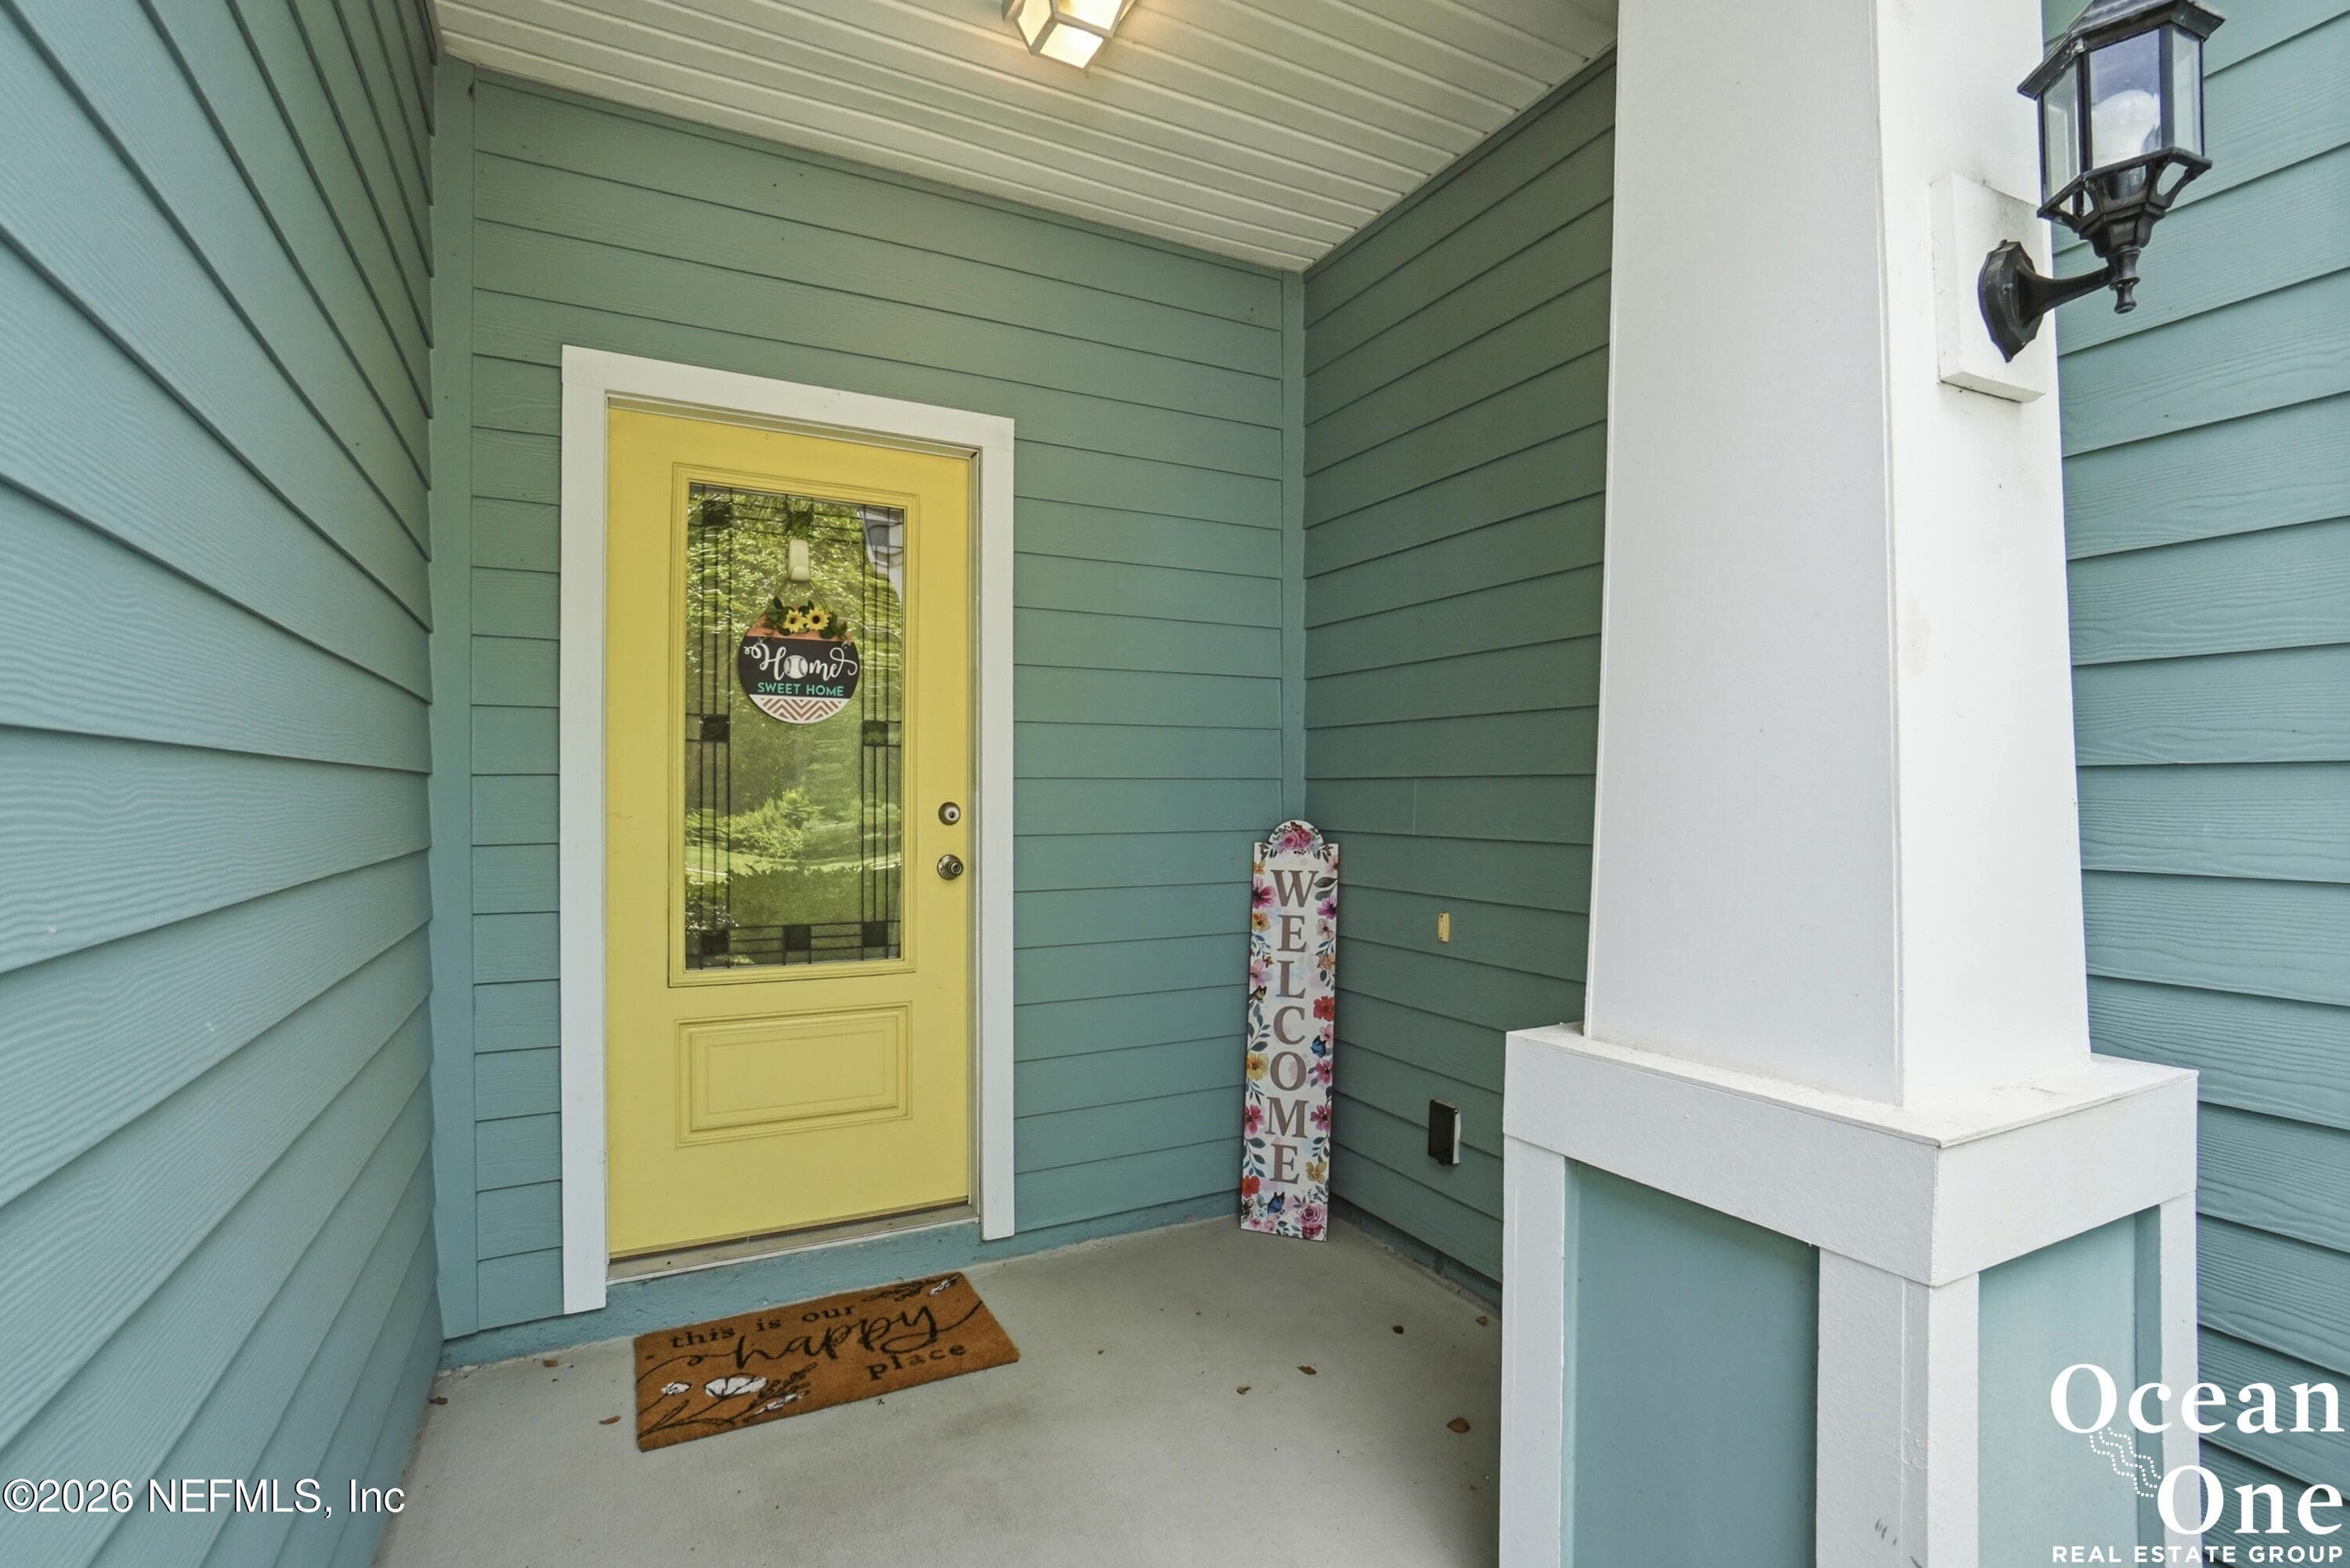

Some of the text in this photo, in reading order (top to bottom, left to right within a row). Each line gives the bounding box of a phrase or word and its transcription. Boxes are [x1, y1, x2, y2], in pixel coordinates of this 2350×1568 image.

[757, 682, 844, 696] SWEET HOME
[1265, 869, 1318, 1185] WELCOME
[670, 1304, 855, 1349] this is our
[686, 1305, 983, 1370] happy
[865, 1342, 967, 1382] place
